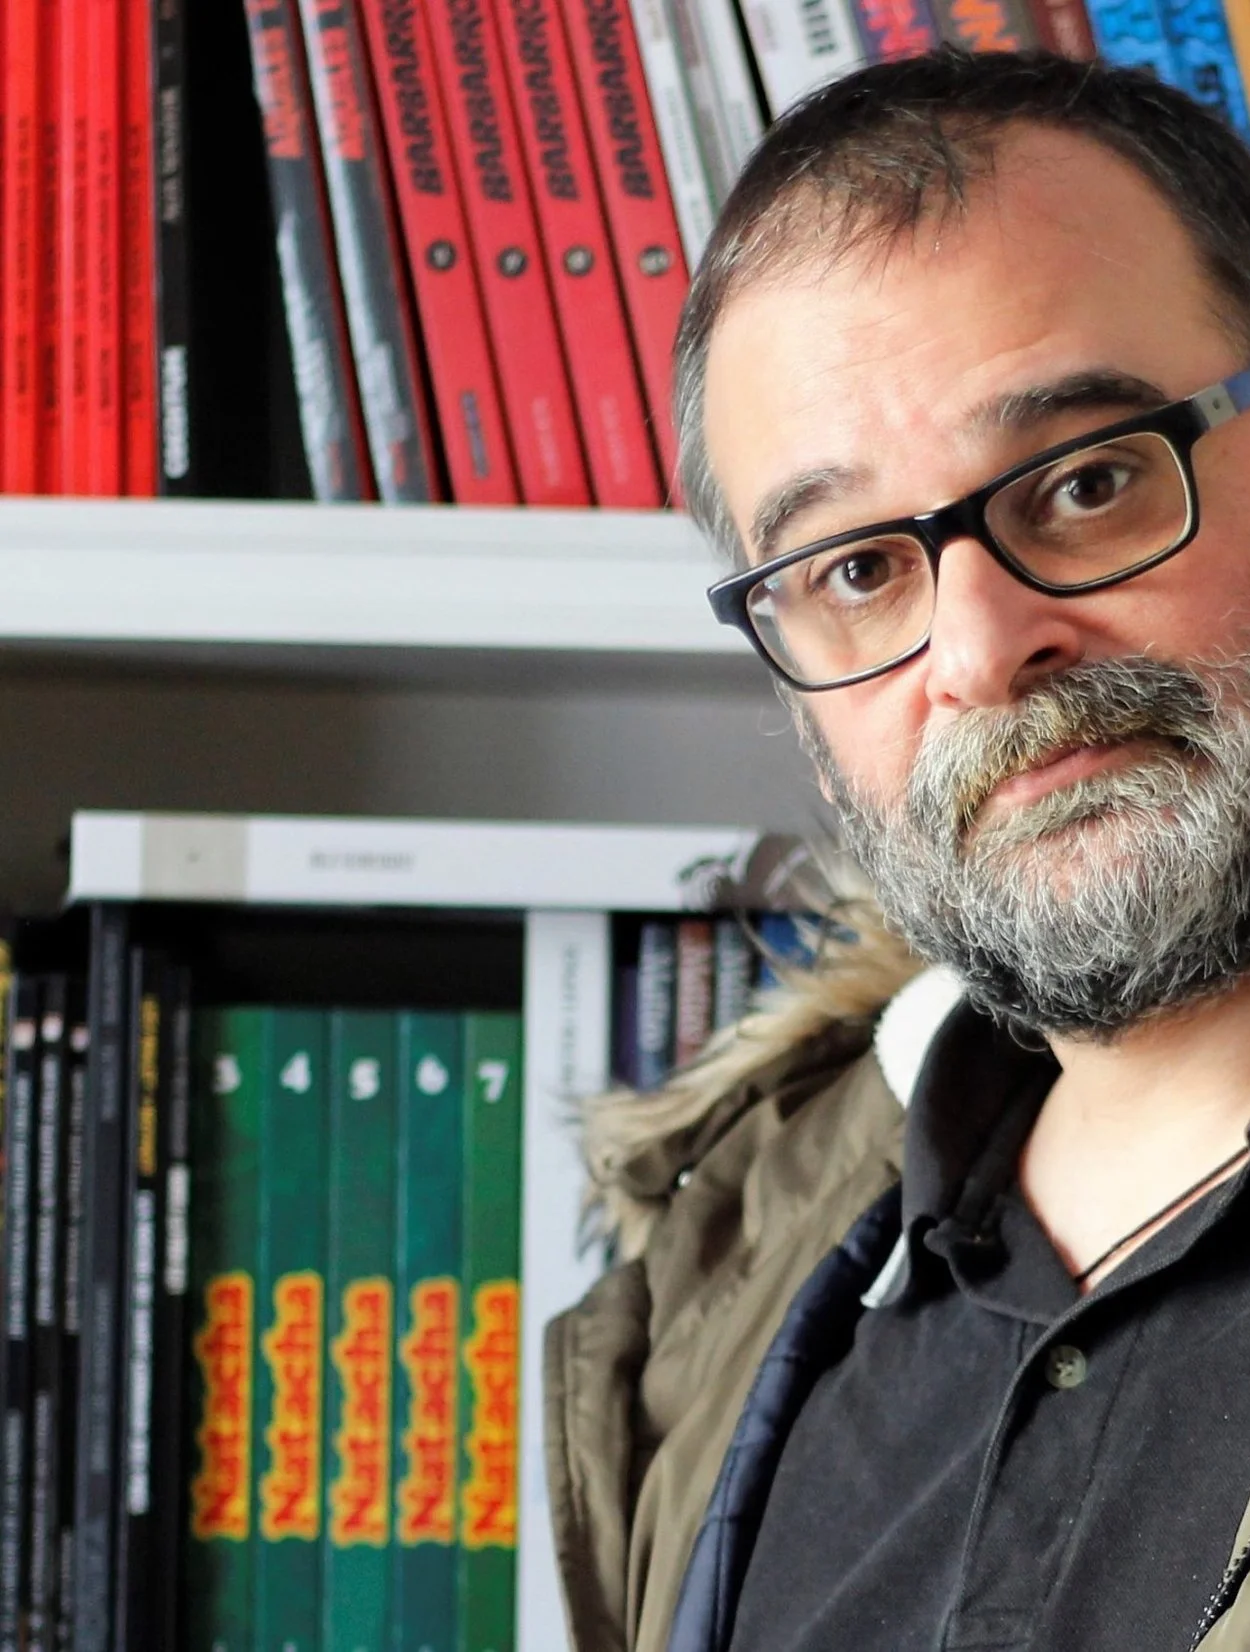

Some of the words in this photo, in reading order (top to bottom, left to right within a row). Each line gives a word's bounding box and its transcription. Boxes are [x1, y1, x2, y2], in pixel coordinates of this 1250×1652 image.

[214, 1052, 241, 1092] 3
[281, 1051, 311, 1093] 4
[350, 1057, 380, 1100] 5
[416, 1052, 448, 1095] 6
[477, 1058, 508, 1103] 7
[197, 1274, 250, 1538] Natacha
[265, 1274, 320, 1538] Natacha
[334, 1279, 390, 1545] Natacha
[400, 1279, 457, 1545] Natacha
[466, 1282, 519, 1548] Natacha
